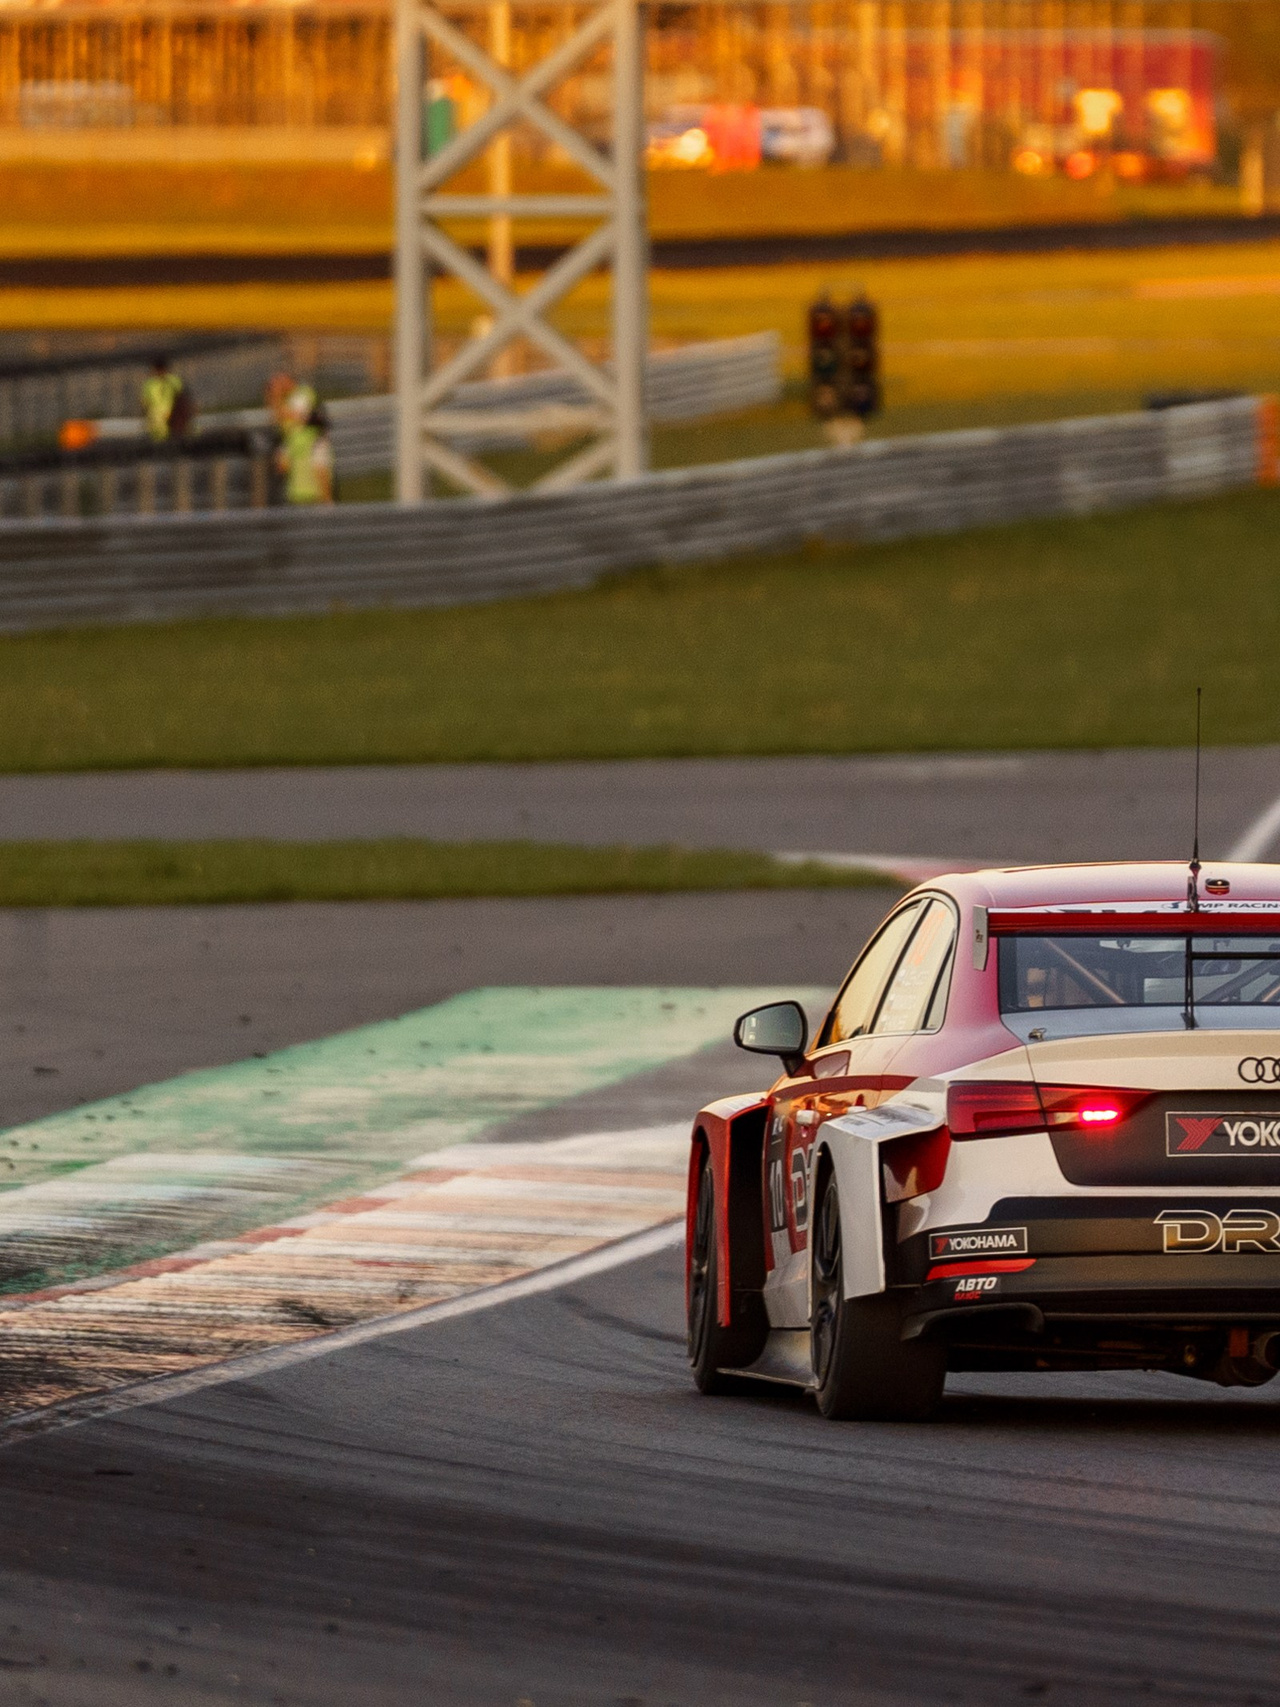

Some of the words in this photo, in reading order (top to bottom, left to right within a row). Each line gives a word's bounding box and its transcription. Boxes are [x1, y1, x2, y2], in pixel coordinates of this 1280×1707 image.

[770, 1159, 784, 1228] 10
[949, 1234, 1017, 1251] YOKOHAMA
[955, 1277, 997, 1292] АВТО
